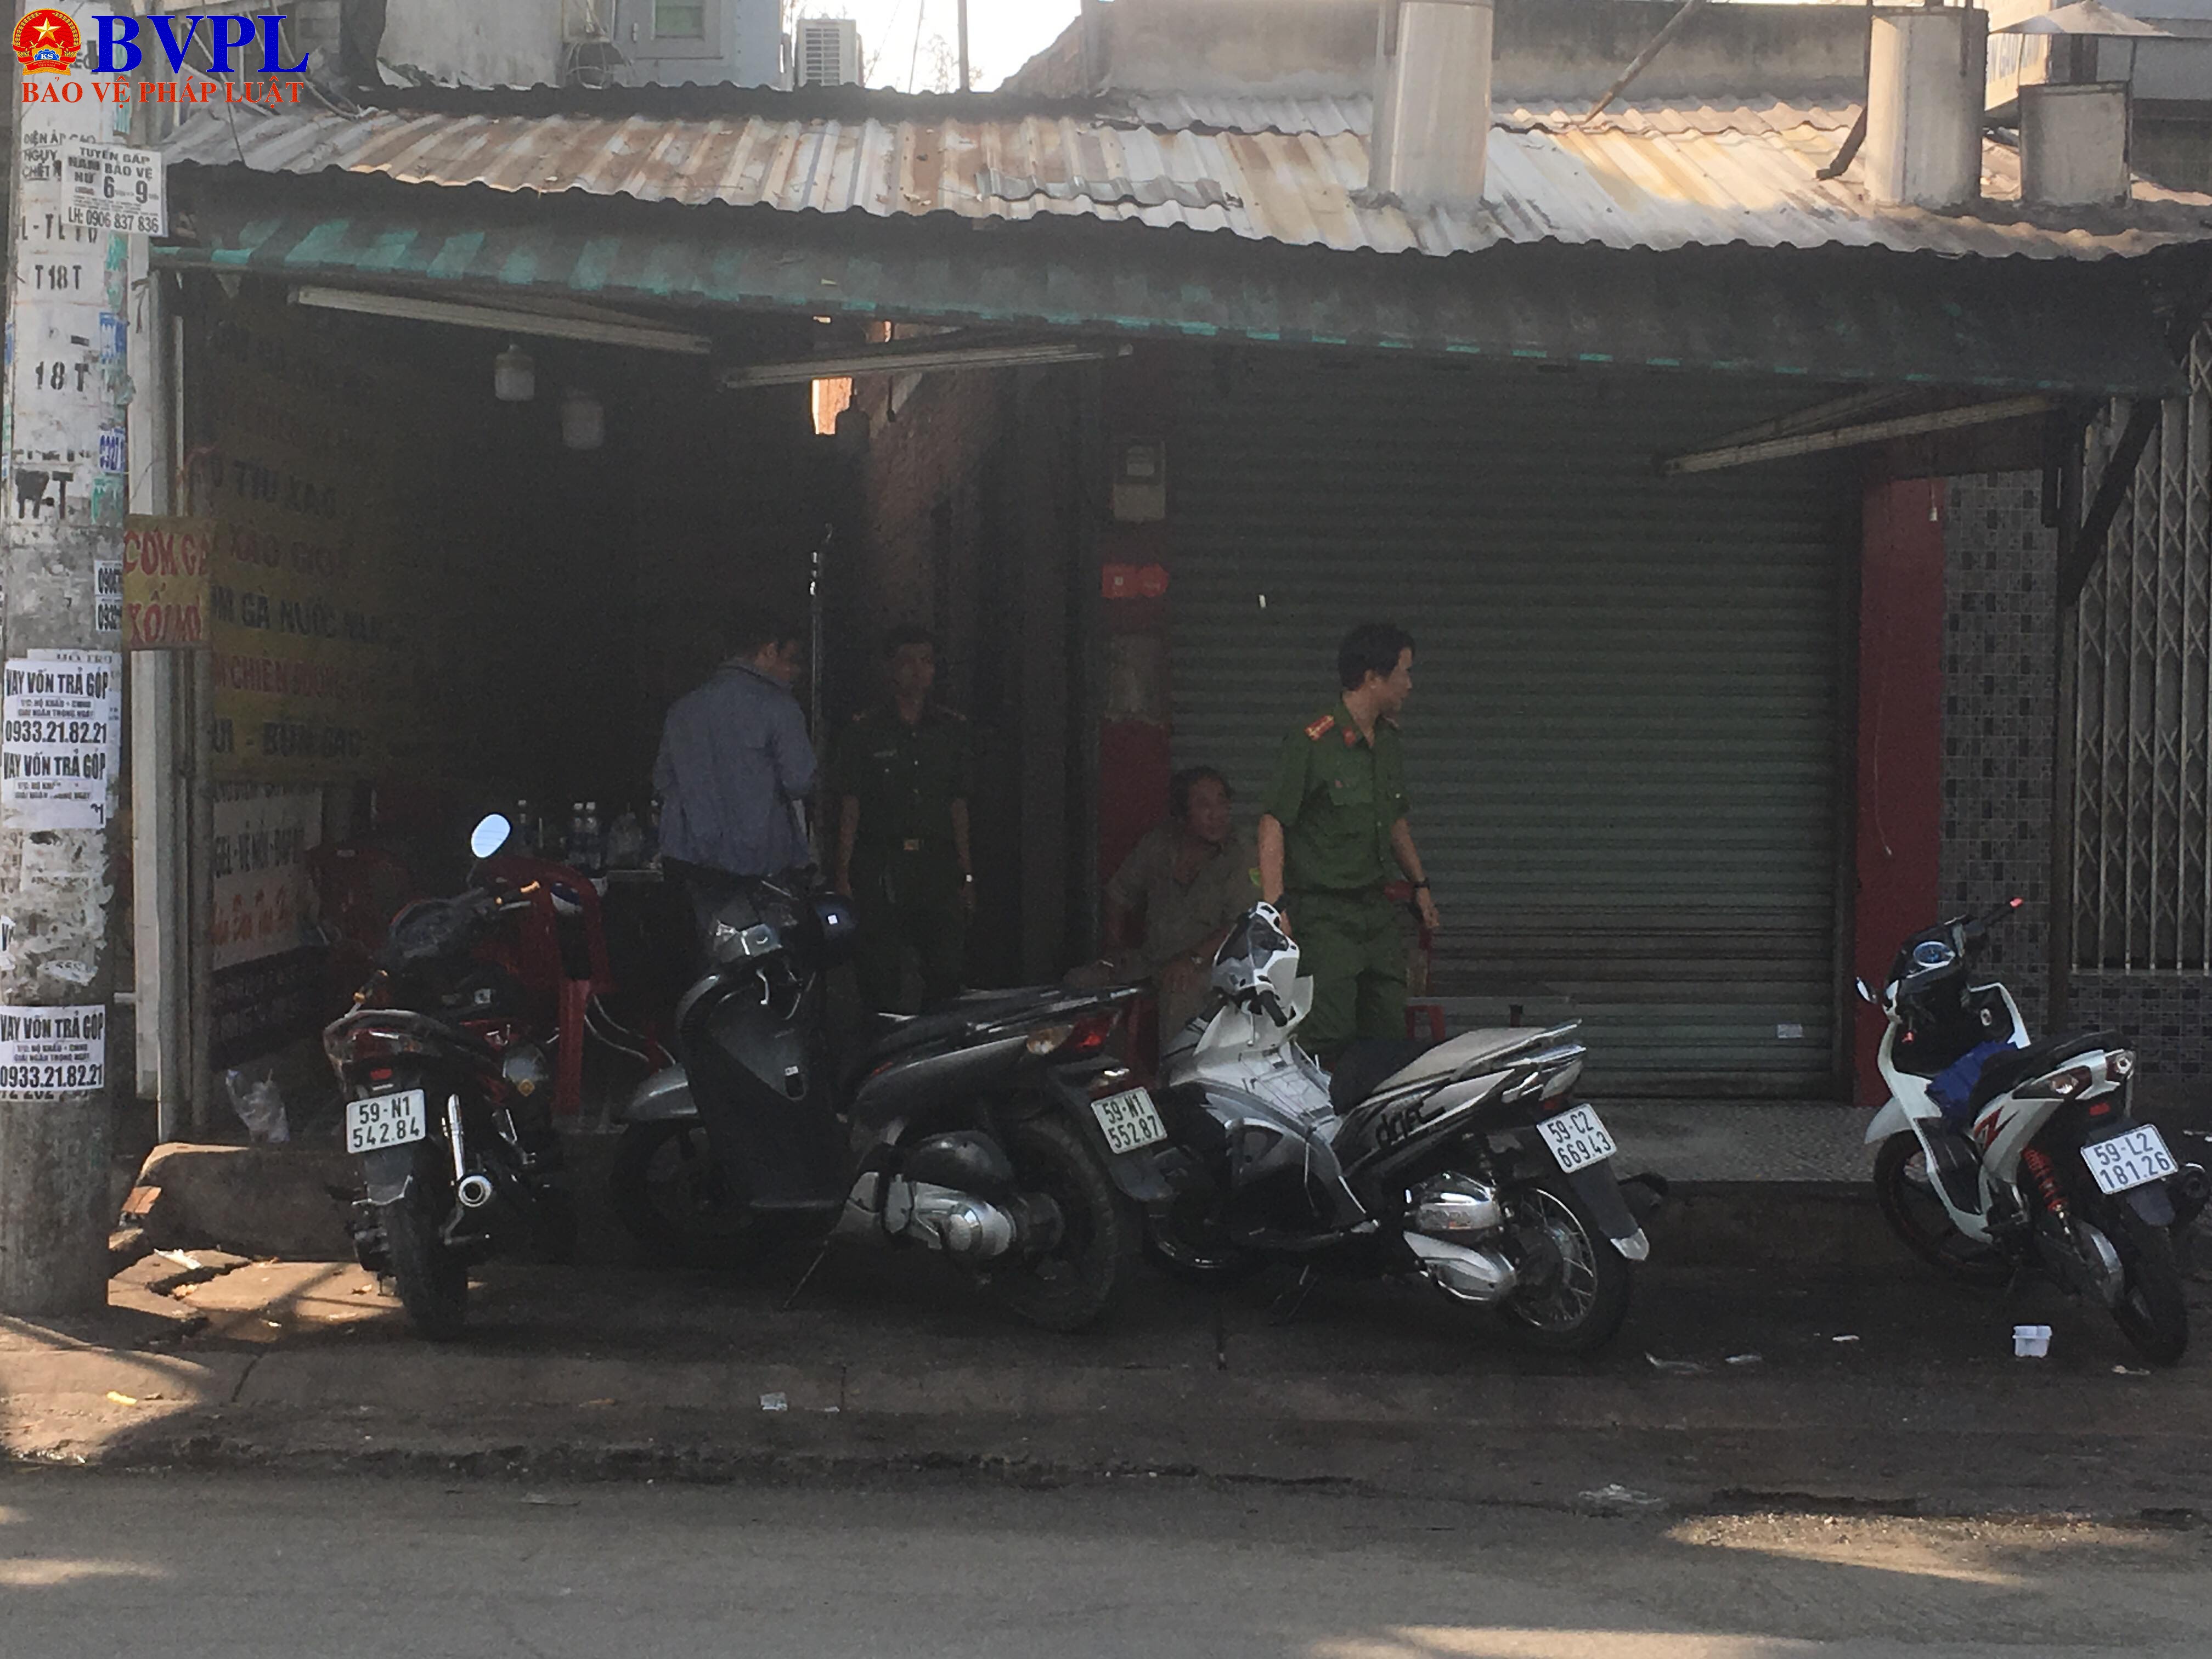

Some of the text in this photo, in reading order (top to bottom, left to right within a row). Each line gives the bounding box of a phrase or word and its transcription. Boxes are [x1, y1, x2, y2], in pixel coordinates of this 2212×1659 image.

[103, 176, 115, 199] 6
[136, 180, 148, 204] 9
[86, 209, 111, 228] 0906
[114, 213, 134, 230] 837
[138, 216, 159, 233] 836
[6, 666, 109, 699] VAY VỐN TRẢ GÓP
[5, 720, 107, 743] 0933.21.82.21
[4, 748, 106, 780] VAY VỐN TRẢ GÓP
[0, 1010, 103, 1041] VAY VỐN TRẢ GÓP
[0, 1063, 103, 1087] 0933.21.82.21
[359, 1097, 410, 1125] 59-N1
[1547, 1110, 1594, 1143] 59-C2
[353, 1116, 420, 1148] 542.84
[1108, 1114, 1159, 1148] 552.87
[1557, 1131, 1611, 1168] 669.43
[2094, 1132, 2153, 1166] 59-L2
[2099, 1151, 2170, 1189] 181.26
